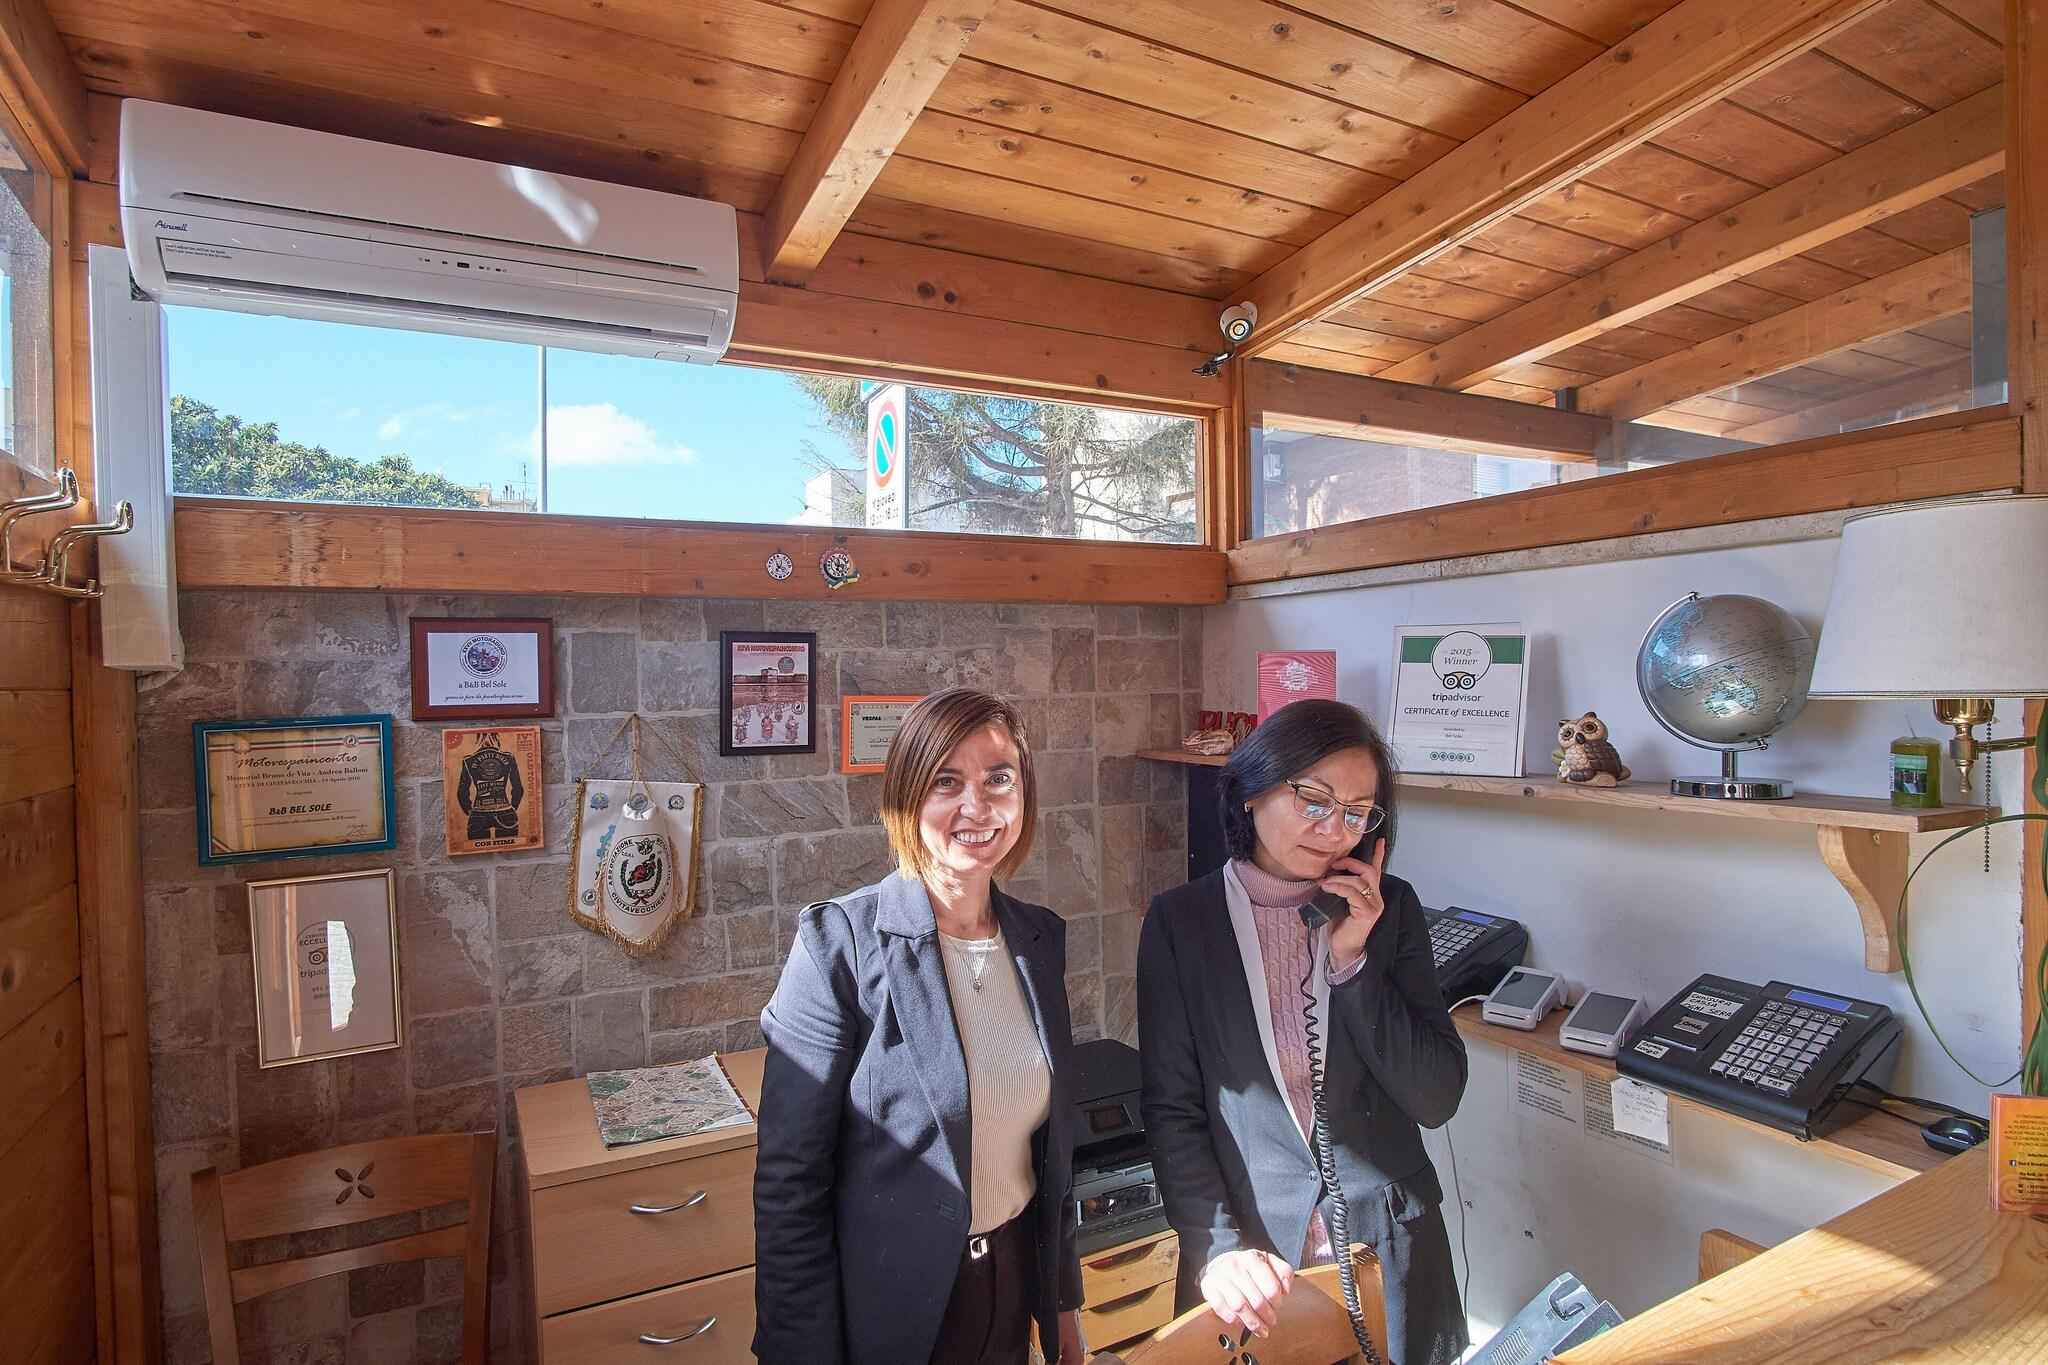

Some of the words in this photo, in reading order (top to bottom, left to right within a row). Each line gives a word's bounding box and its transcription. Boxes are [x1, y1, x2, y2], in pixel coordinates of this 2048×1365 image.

[154, 220, 188, 232] Airwell
[1450, 648, 1473, 656] 2015
[1444, 656, 1478, 666] Winner
[1432, 692, 1482, 703] tripadvisor
[1404, 707, 1449, 716] CERTIFICATE
[1450, 707, 1460, 718] of
[1462, 708, 1510, 718] EXCELLENCE
[236, 752, 358, 770] Motovespaincontro
[265, 778, 317, 786] CIVITAVECCHIA
[268, 807, 287, 816] B&B
[290, 805, 307, 814] BEL
[309, 803, 332, 812] SOLE
[608, 839, 633, 886] ASSOCIAZIONE
[300, 966, 328, 978] tripad
[1689, 999, 1718, 1008] CASSA
[1691, 993, 1732, 1006] CHIUSURA
[1684, 1002, 1704, 1011] OGNI
[1708, 1008, 1733, 1017] SERA
[1767, 1079, 1784, 1087] TOT
